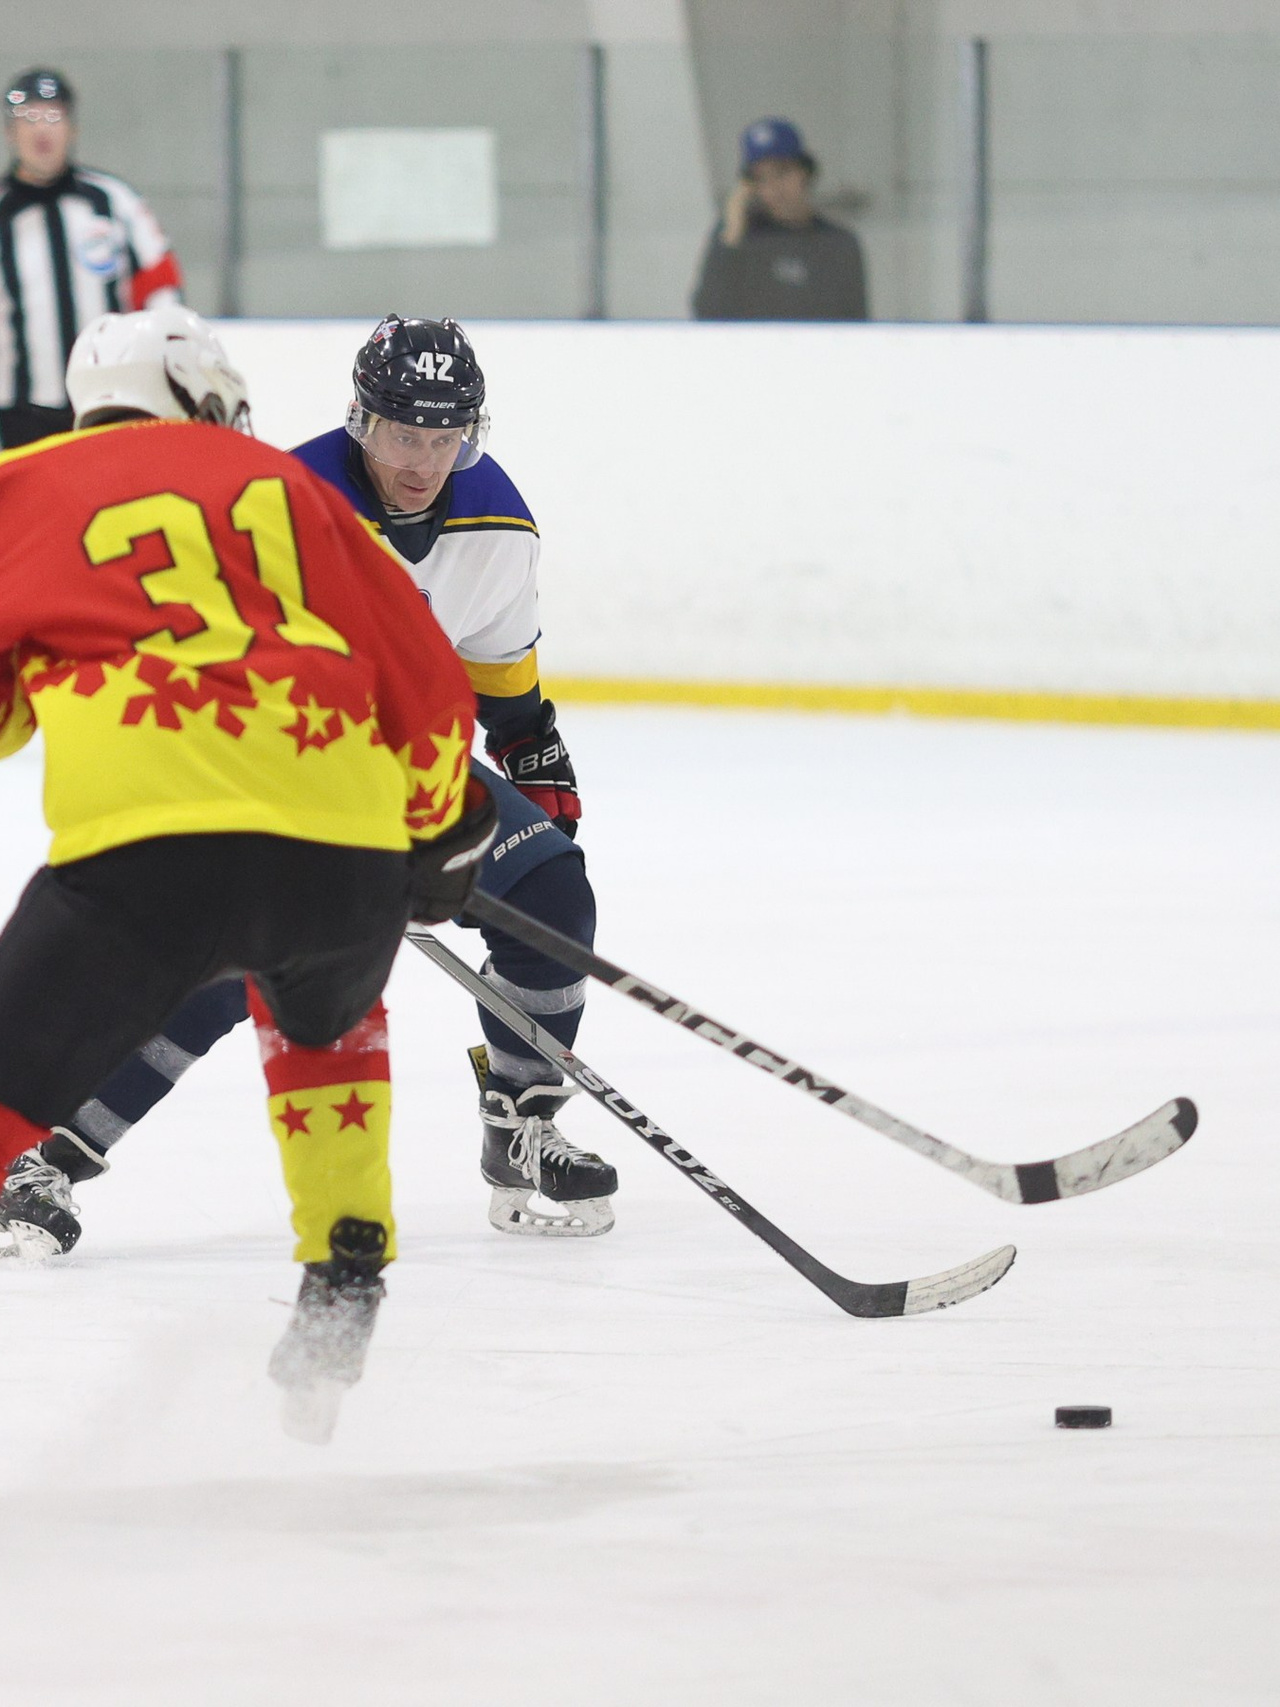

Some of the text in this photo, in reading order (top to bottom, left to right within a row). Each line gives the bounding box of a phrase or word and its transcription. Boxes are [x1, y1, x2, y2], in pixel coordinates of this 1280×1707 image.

[415, 351, 455, 383] 42
[413, 400, 456, 409] BAUER
[82, 477, 351, 667] 31
[493, 821, 555, 861] BAUER
[681, 1013, 847, 1105] CCM
